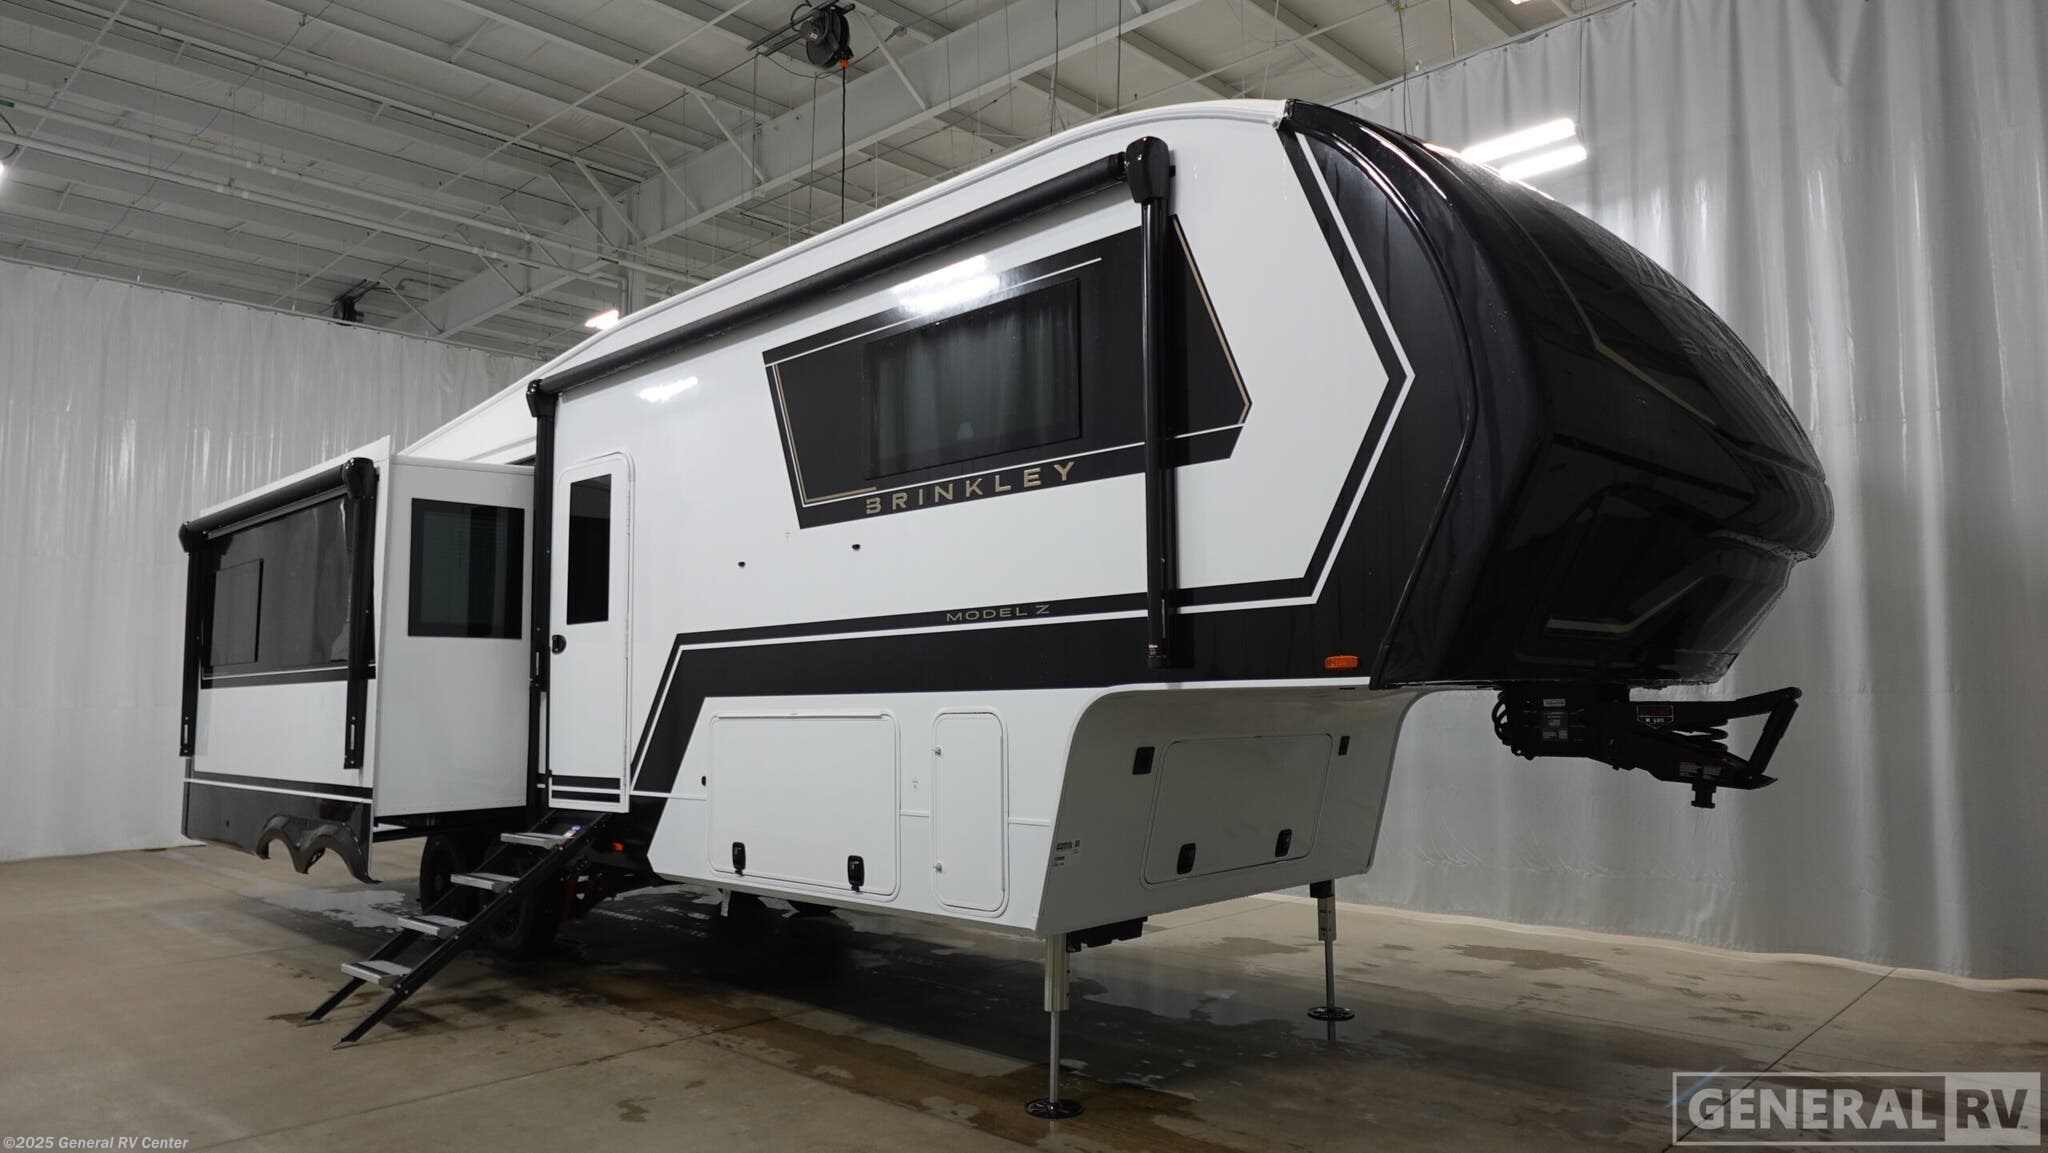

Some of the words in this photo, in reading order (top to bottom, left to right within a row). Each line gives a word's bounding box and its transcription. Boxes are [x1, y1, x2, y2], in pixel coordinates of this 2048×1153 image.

[866, 461, 1075, 515] BRINKLEY
[946, 606, 1028, 622] MODEL
[1035, 604, 1049, 615] Z
